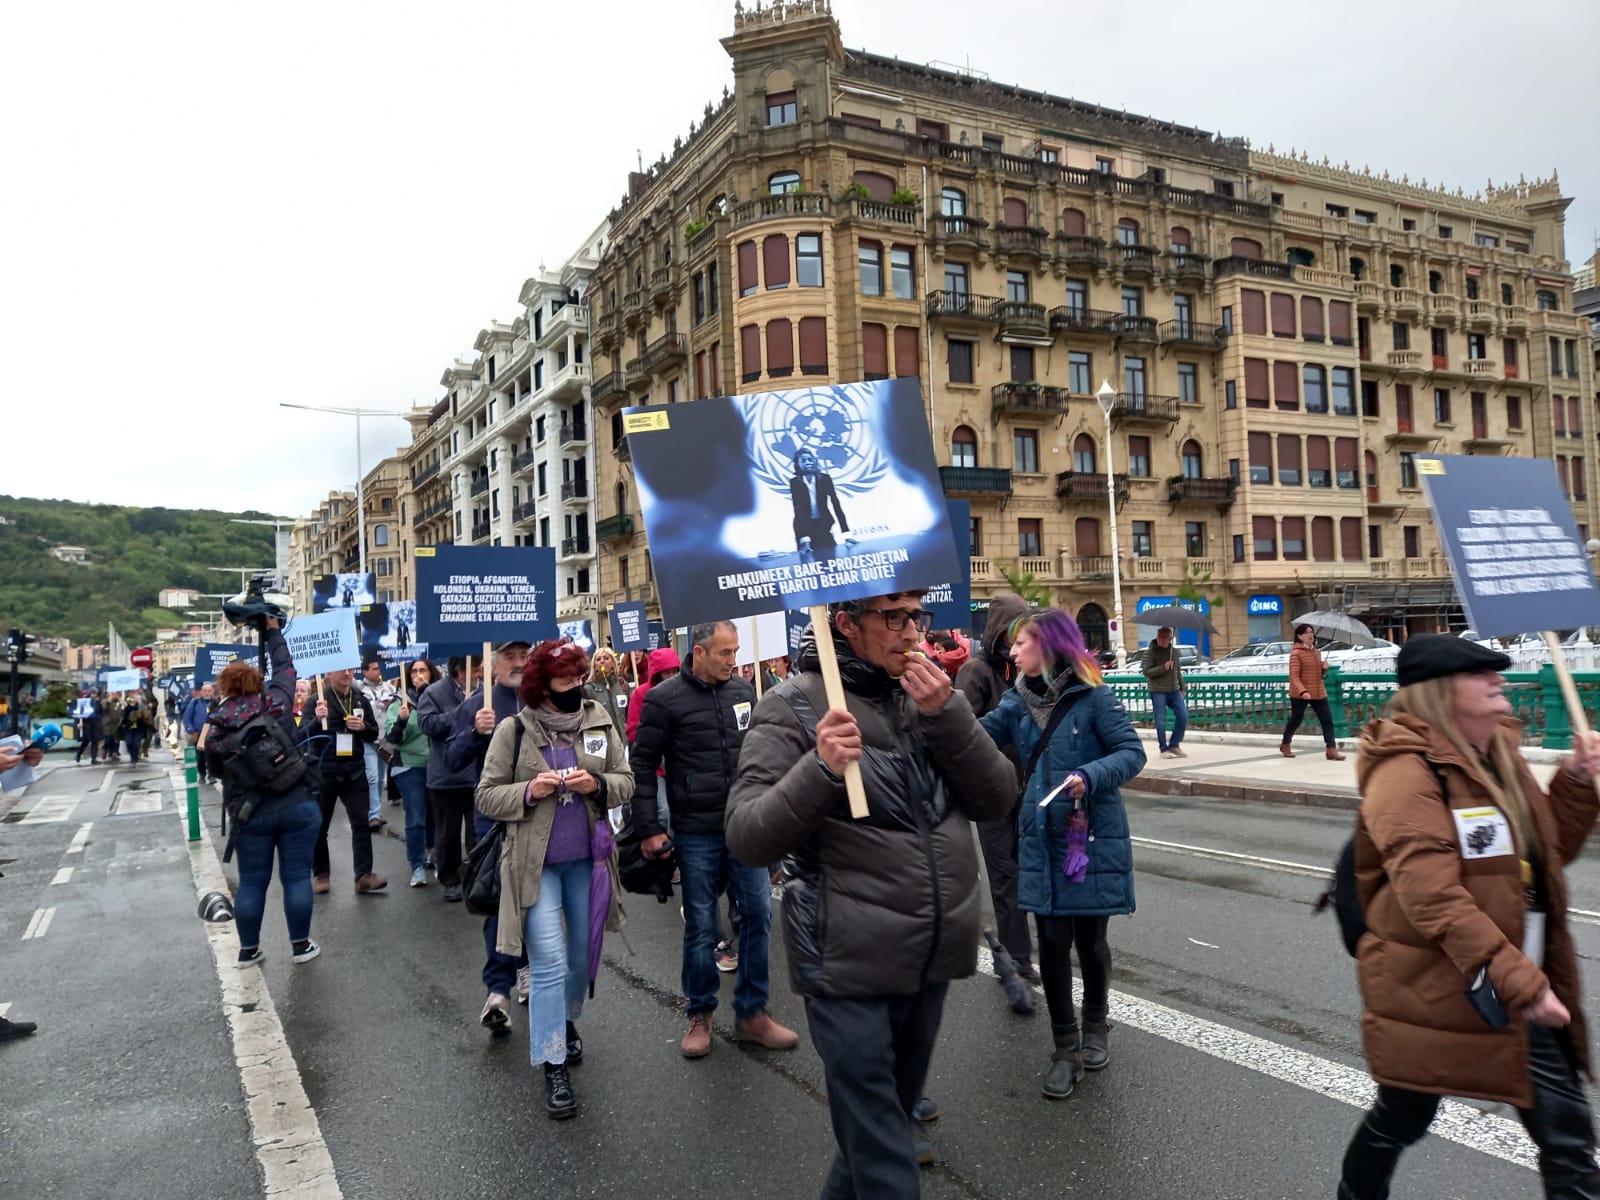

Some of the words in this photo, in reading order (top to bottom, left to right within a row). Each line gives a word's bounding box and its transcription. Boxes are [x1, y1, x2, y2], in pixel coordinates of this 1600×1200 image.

[717, 565, 793, 590] EMAKUMEEK
[794, 549, 909, 579] BAKE-PROZESUETAN
[449, 575, 481, 585] ETIOPIA,
[483, 575, 530, 585] AFGANISTAN,
[738, 582, 778, 601] PARTE
[779, 577, 819, 594] HARTU
[821, 570, 860, 588] BEHAR
[861, 564, 897, 582] DUTE!
[433, 585, 473, 594] KOLONBIA,
[475, 585, 509, 594] UKRAINA,
[440, 594, 473, 603] GATAZKA
[474, 594, 505, 603] GUZTIEK
[506, 594, 536, 603] DITUZTE
[441, 603, 476, 613] ONDORIO
[477, 603, 536, 613] SUNTSITZAILEAK
[1259, 601, 1279, 612] IMQ
[439, 613, 477, 623] EMAKUME
[478, 613, 492, 623] ETA
[493, 612, 539, 623] NESKENTZAT.
[288, 631, 330, 646] EMAKUMEAK
[331, 629, 340, 639] EZ
[290, 642, 308, 654] DIRA
[308, 638, 340, 651] GERRAKO
